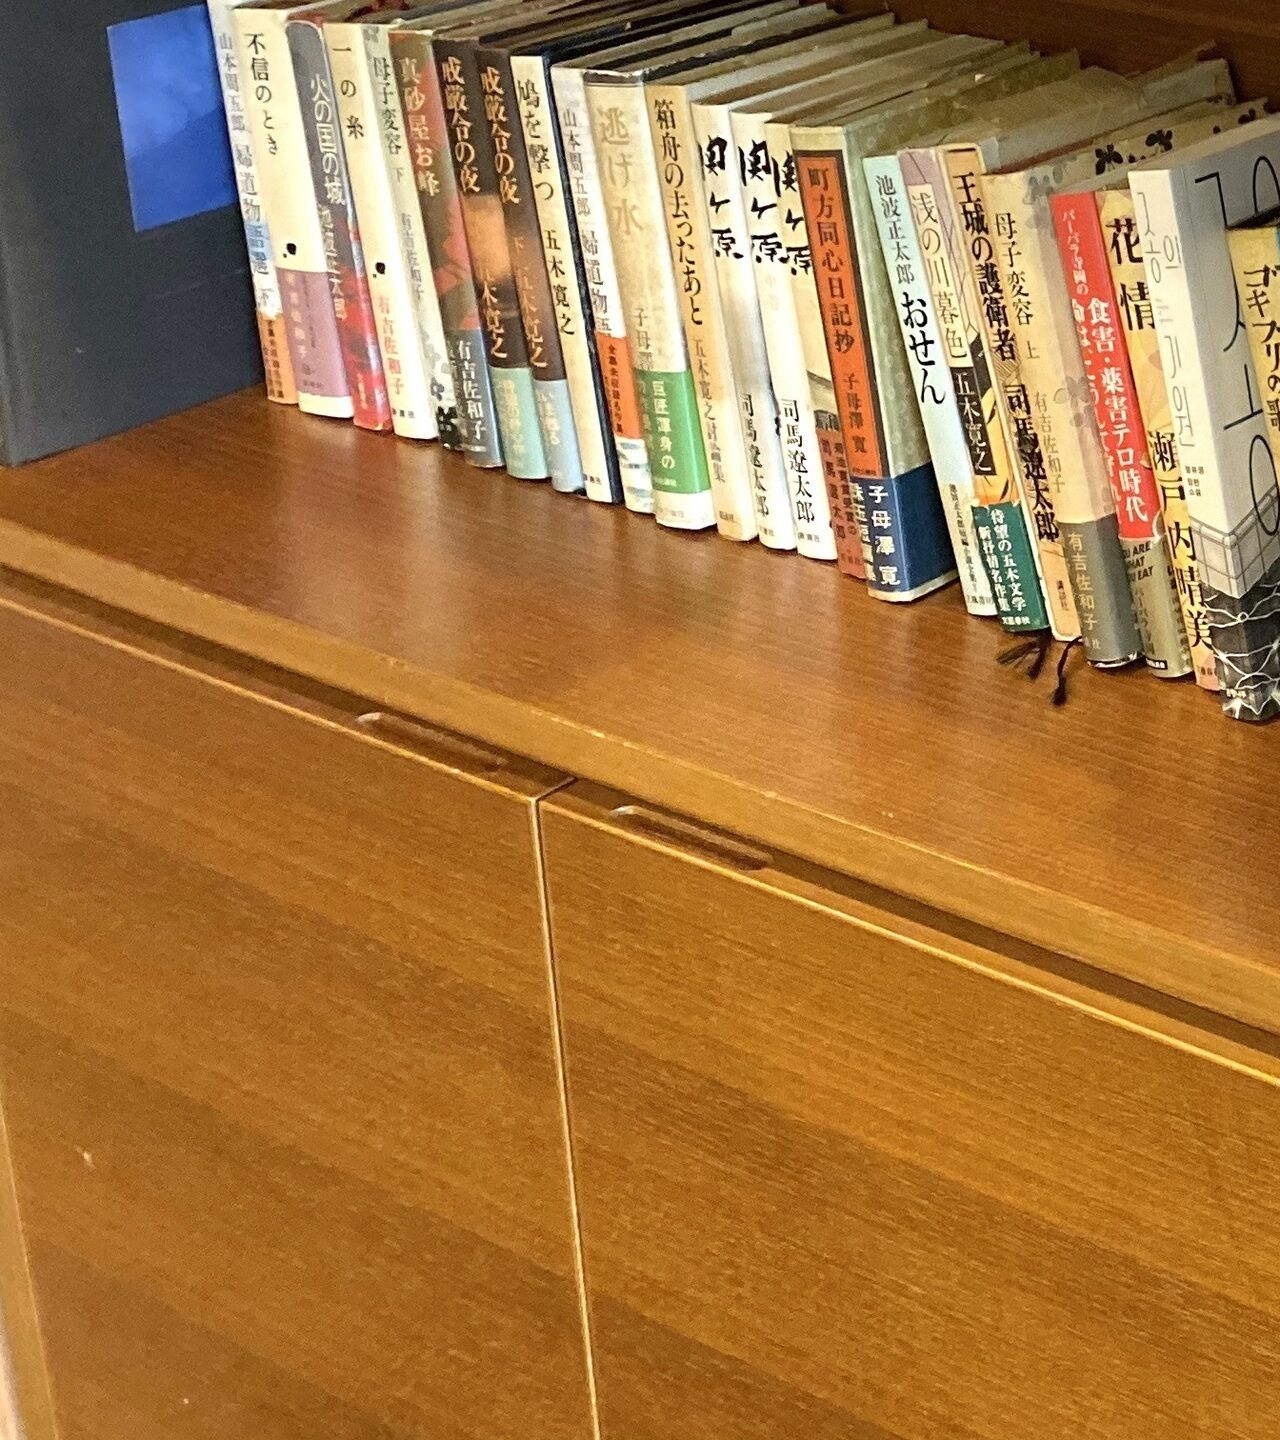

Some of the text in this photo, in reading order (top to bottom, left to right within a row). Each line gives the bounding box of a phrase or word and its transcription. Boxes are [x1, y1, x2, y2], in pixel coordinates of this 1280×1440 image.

[246, 32, 279, 156] 不信のとき
[331, 46, 365, 140] 一の糸
[372, 55, 402, 156] 母子変容
[400, 56, 441, 197] 真砂屋お峰
[442, 55, 481, 194] 戒厳令の夜
[480, 65, 522, 205] 戒厳令の夜
[562, 108, 591, 217] 山本周五郎
[654, 98, 703, 326] 箱舟の去ったあと
[807, 167, 855, 355] 町方同心日記抄
[912, 191, 968, 359] 浅の川暮色
[952, 171, 1017, 363] 王城の護衛者
[1105, 217, 1157, 331] 花情
[543, 228, 575, 336] 五木寛之
[875, 173, 947, 406] 池波正太郎 おせん
[995, 211, 1040, 360] 母子変容 上
[739, 393, 770, 518] 司馬遼太郎
[779, 397, 815, 524] 司馬遼太郎
[954, 371, 993, 474] 五木寛之
[1005, 382, 1060, 544] 司馬遼太郎
[1087, 296, 1150, 525] 食害・薬害テロ時代
[990, 508, 1027, 612] 待望の五木文学
[1147, 430, 1214, 649] 瀬戸内晴美
